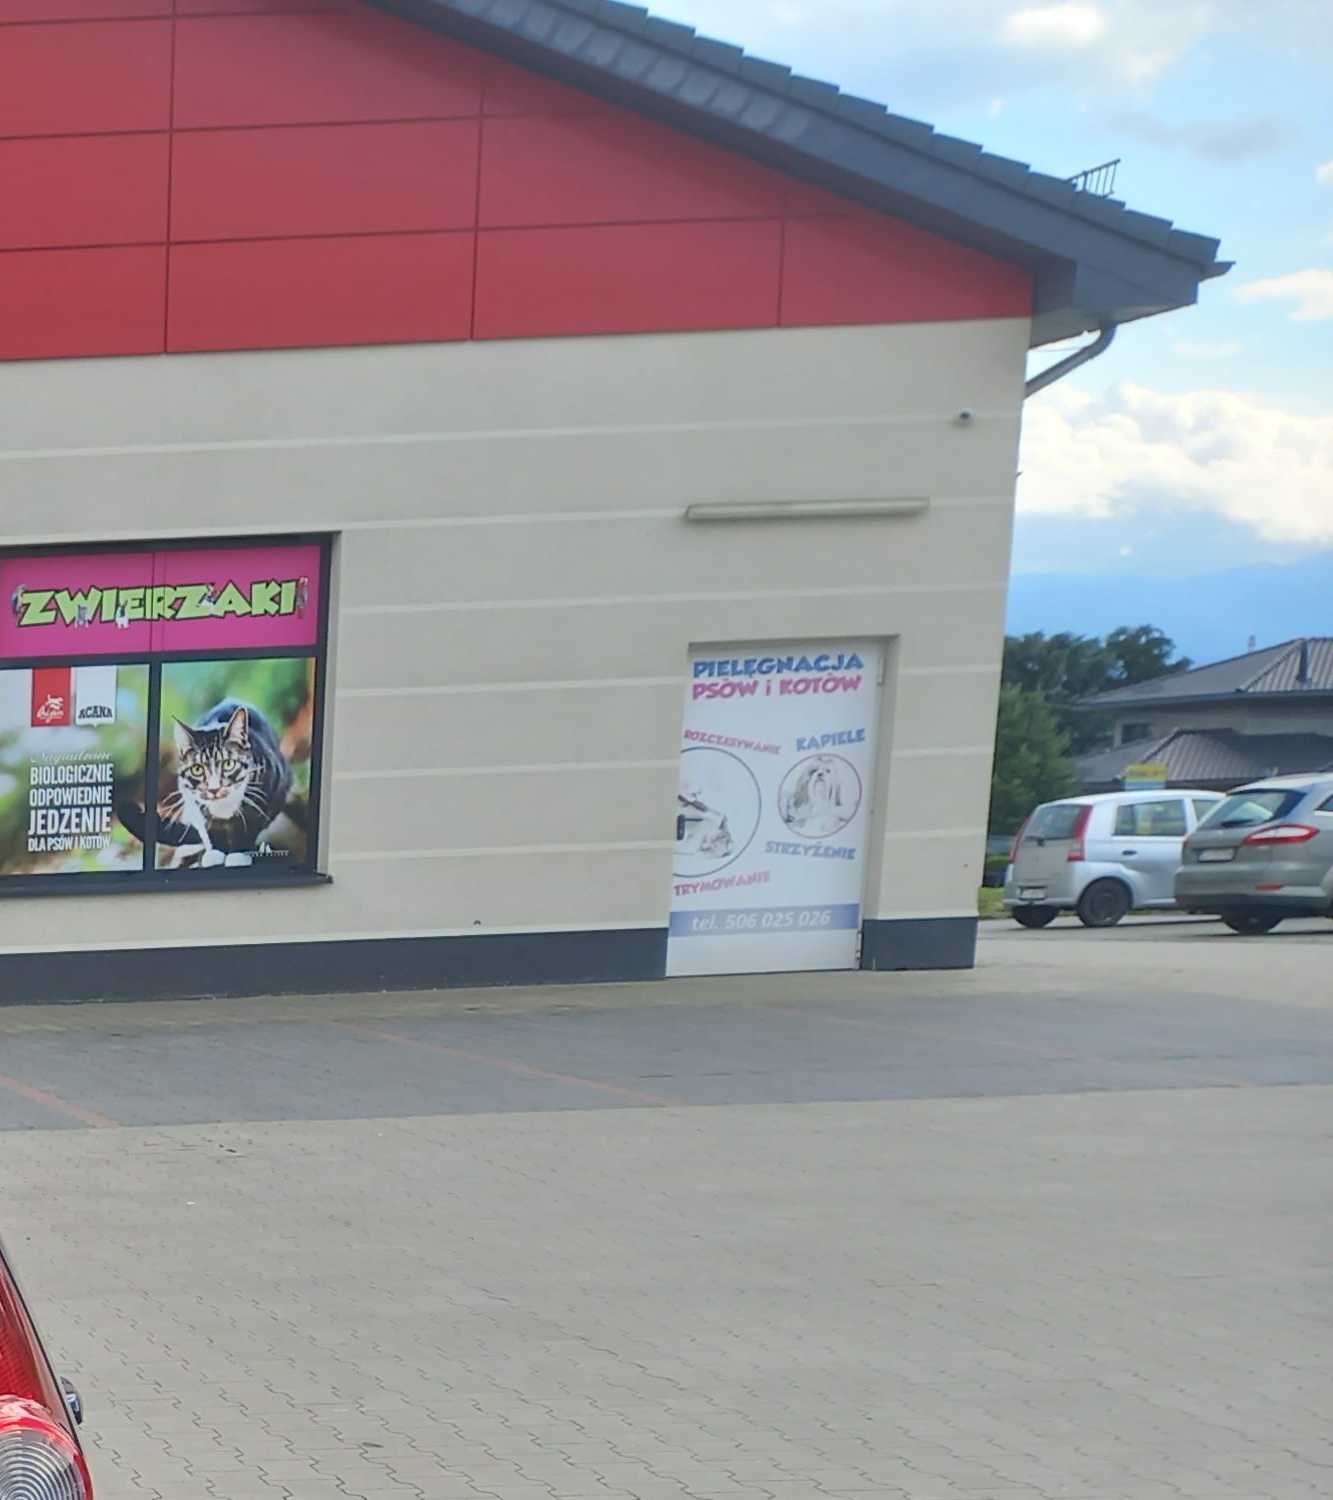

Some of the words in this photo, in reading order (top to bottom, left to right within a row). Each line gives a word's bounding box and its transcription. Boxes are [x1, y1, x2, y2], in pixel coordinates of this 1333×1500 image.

[16, 576, 299, 628] ZWIERZAKI
[693, 652, 865, 679] PIELĘGNACJA
[692, 678, 759, 700] PSÓW
[779, 672, 863, 696] KOTÓW
[78, 705, 113, 719] ACANA
[30, 763, 114, 785] BIOLOGICZNIE
[29, 785, 113, 807] ODPOWIEDNIE
[28, 806, 113, 836] JEDZENIE
[28, 837, 46, 852] DLA
[47, 834, 73, 852] PSÓW
[80, 833, 111, 850] KOTÓW
[765, 841, 857, 860] STRZYŻENIE
[673, 870, 772, 897] TRYMOWANIE
[692, 914, 719, 931] tel.
[724, 913, 758, 930] 506
[762, 911, 795, 928] 025
[799, 909, 832, 926] 026
